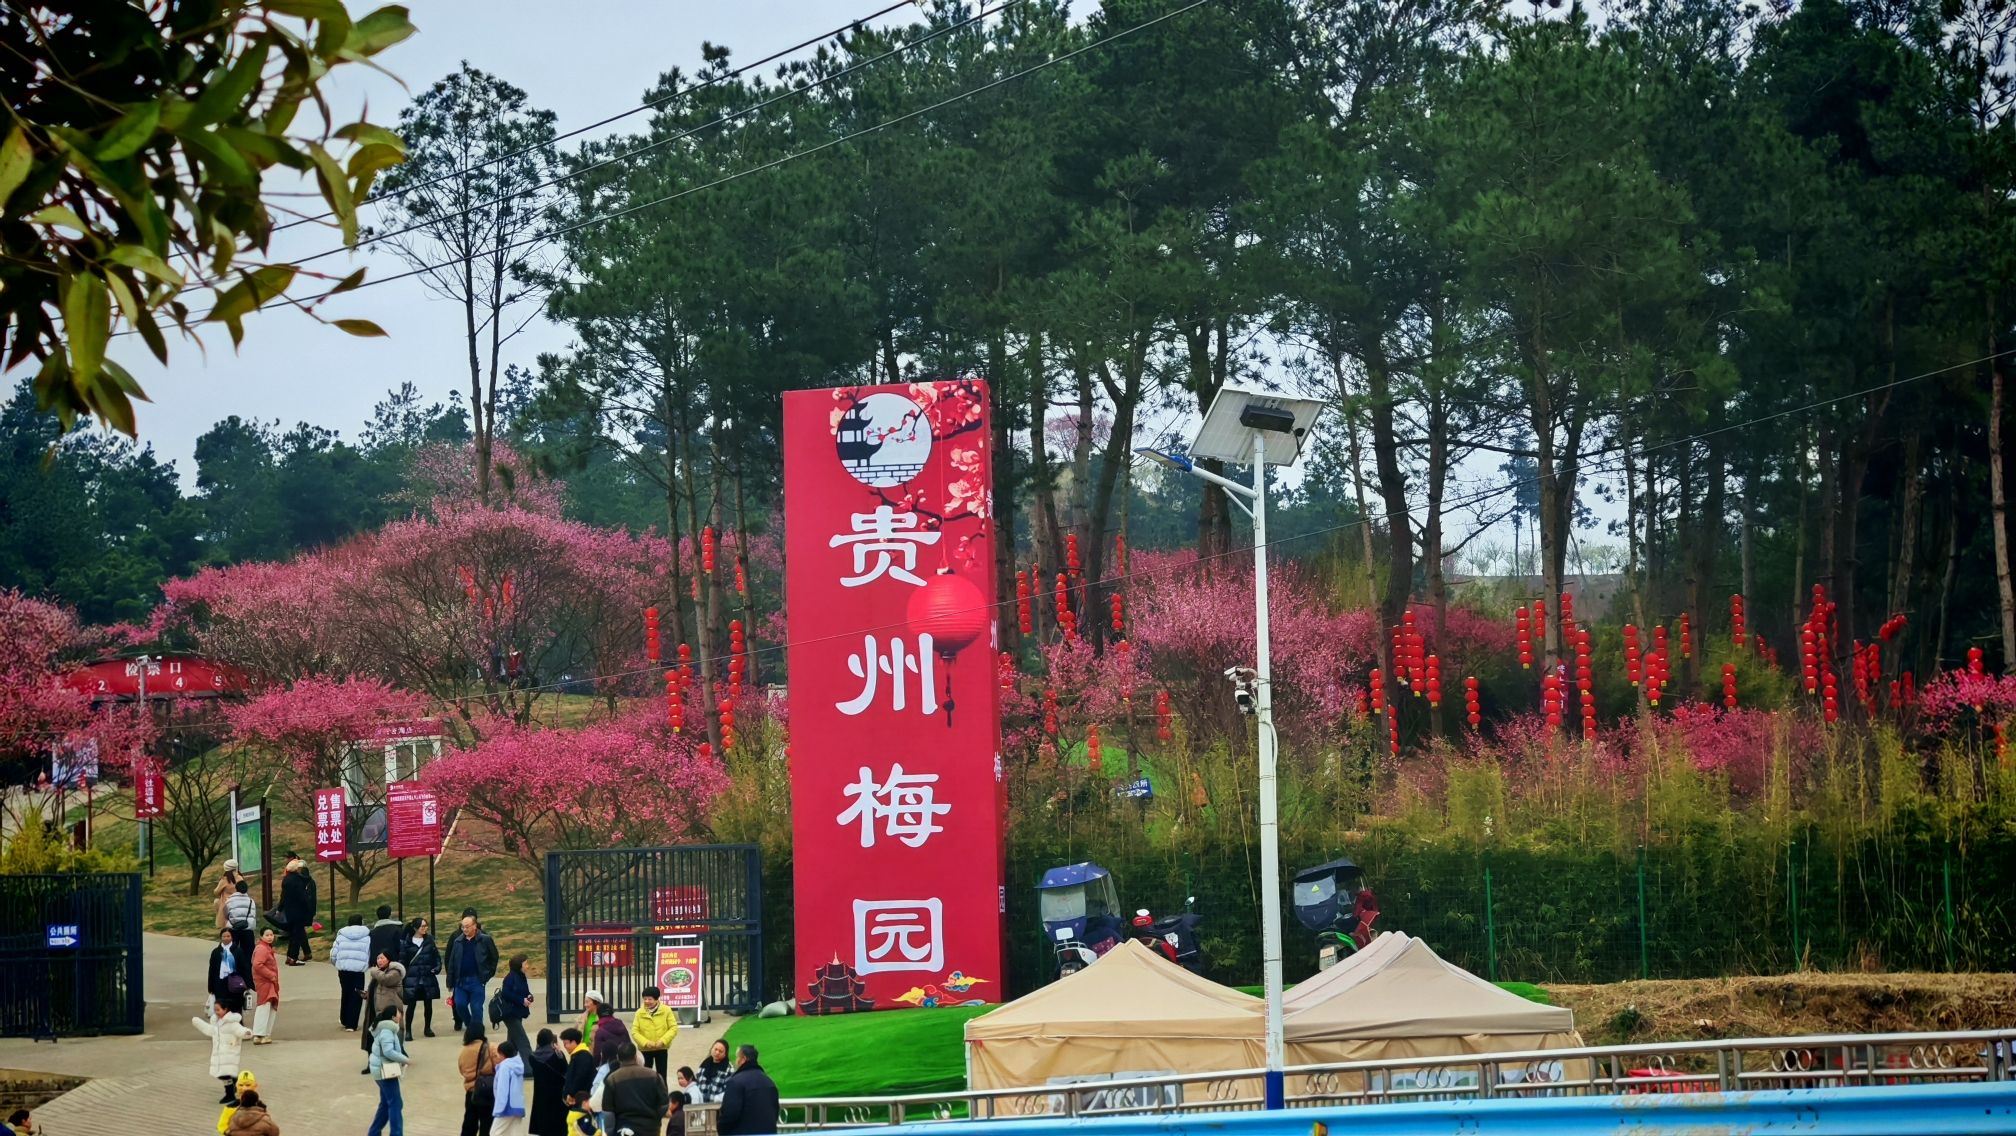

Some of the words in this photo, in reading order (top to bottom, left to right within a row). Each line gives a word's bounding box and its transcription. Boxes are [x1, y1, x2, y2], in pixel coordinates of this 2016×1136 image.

[98, 680, 106, 691] 2
[175, 677, 184, 688] 4
[829, 505, 951, 977] 贵州梅园
[317, 794, 329, 845] 兑票处
[330, 793, 342, 844] 售票处
